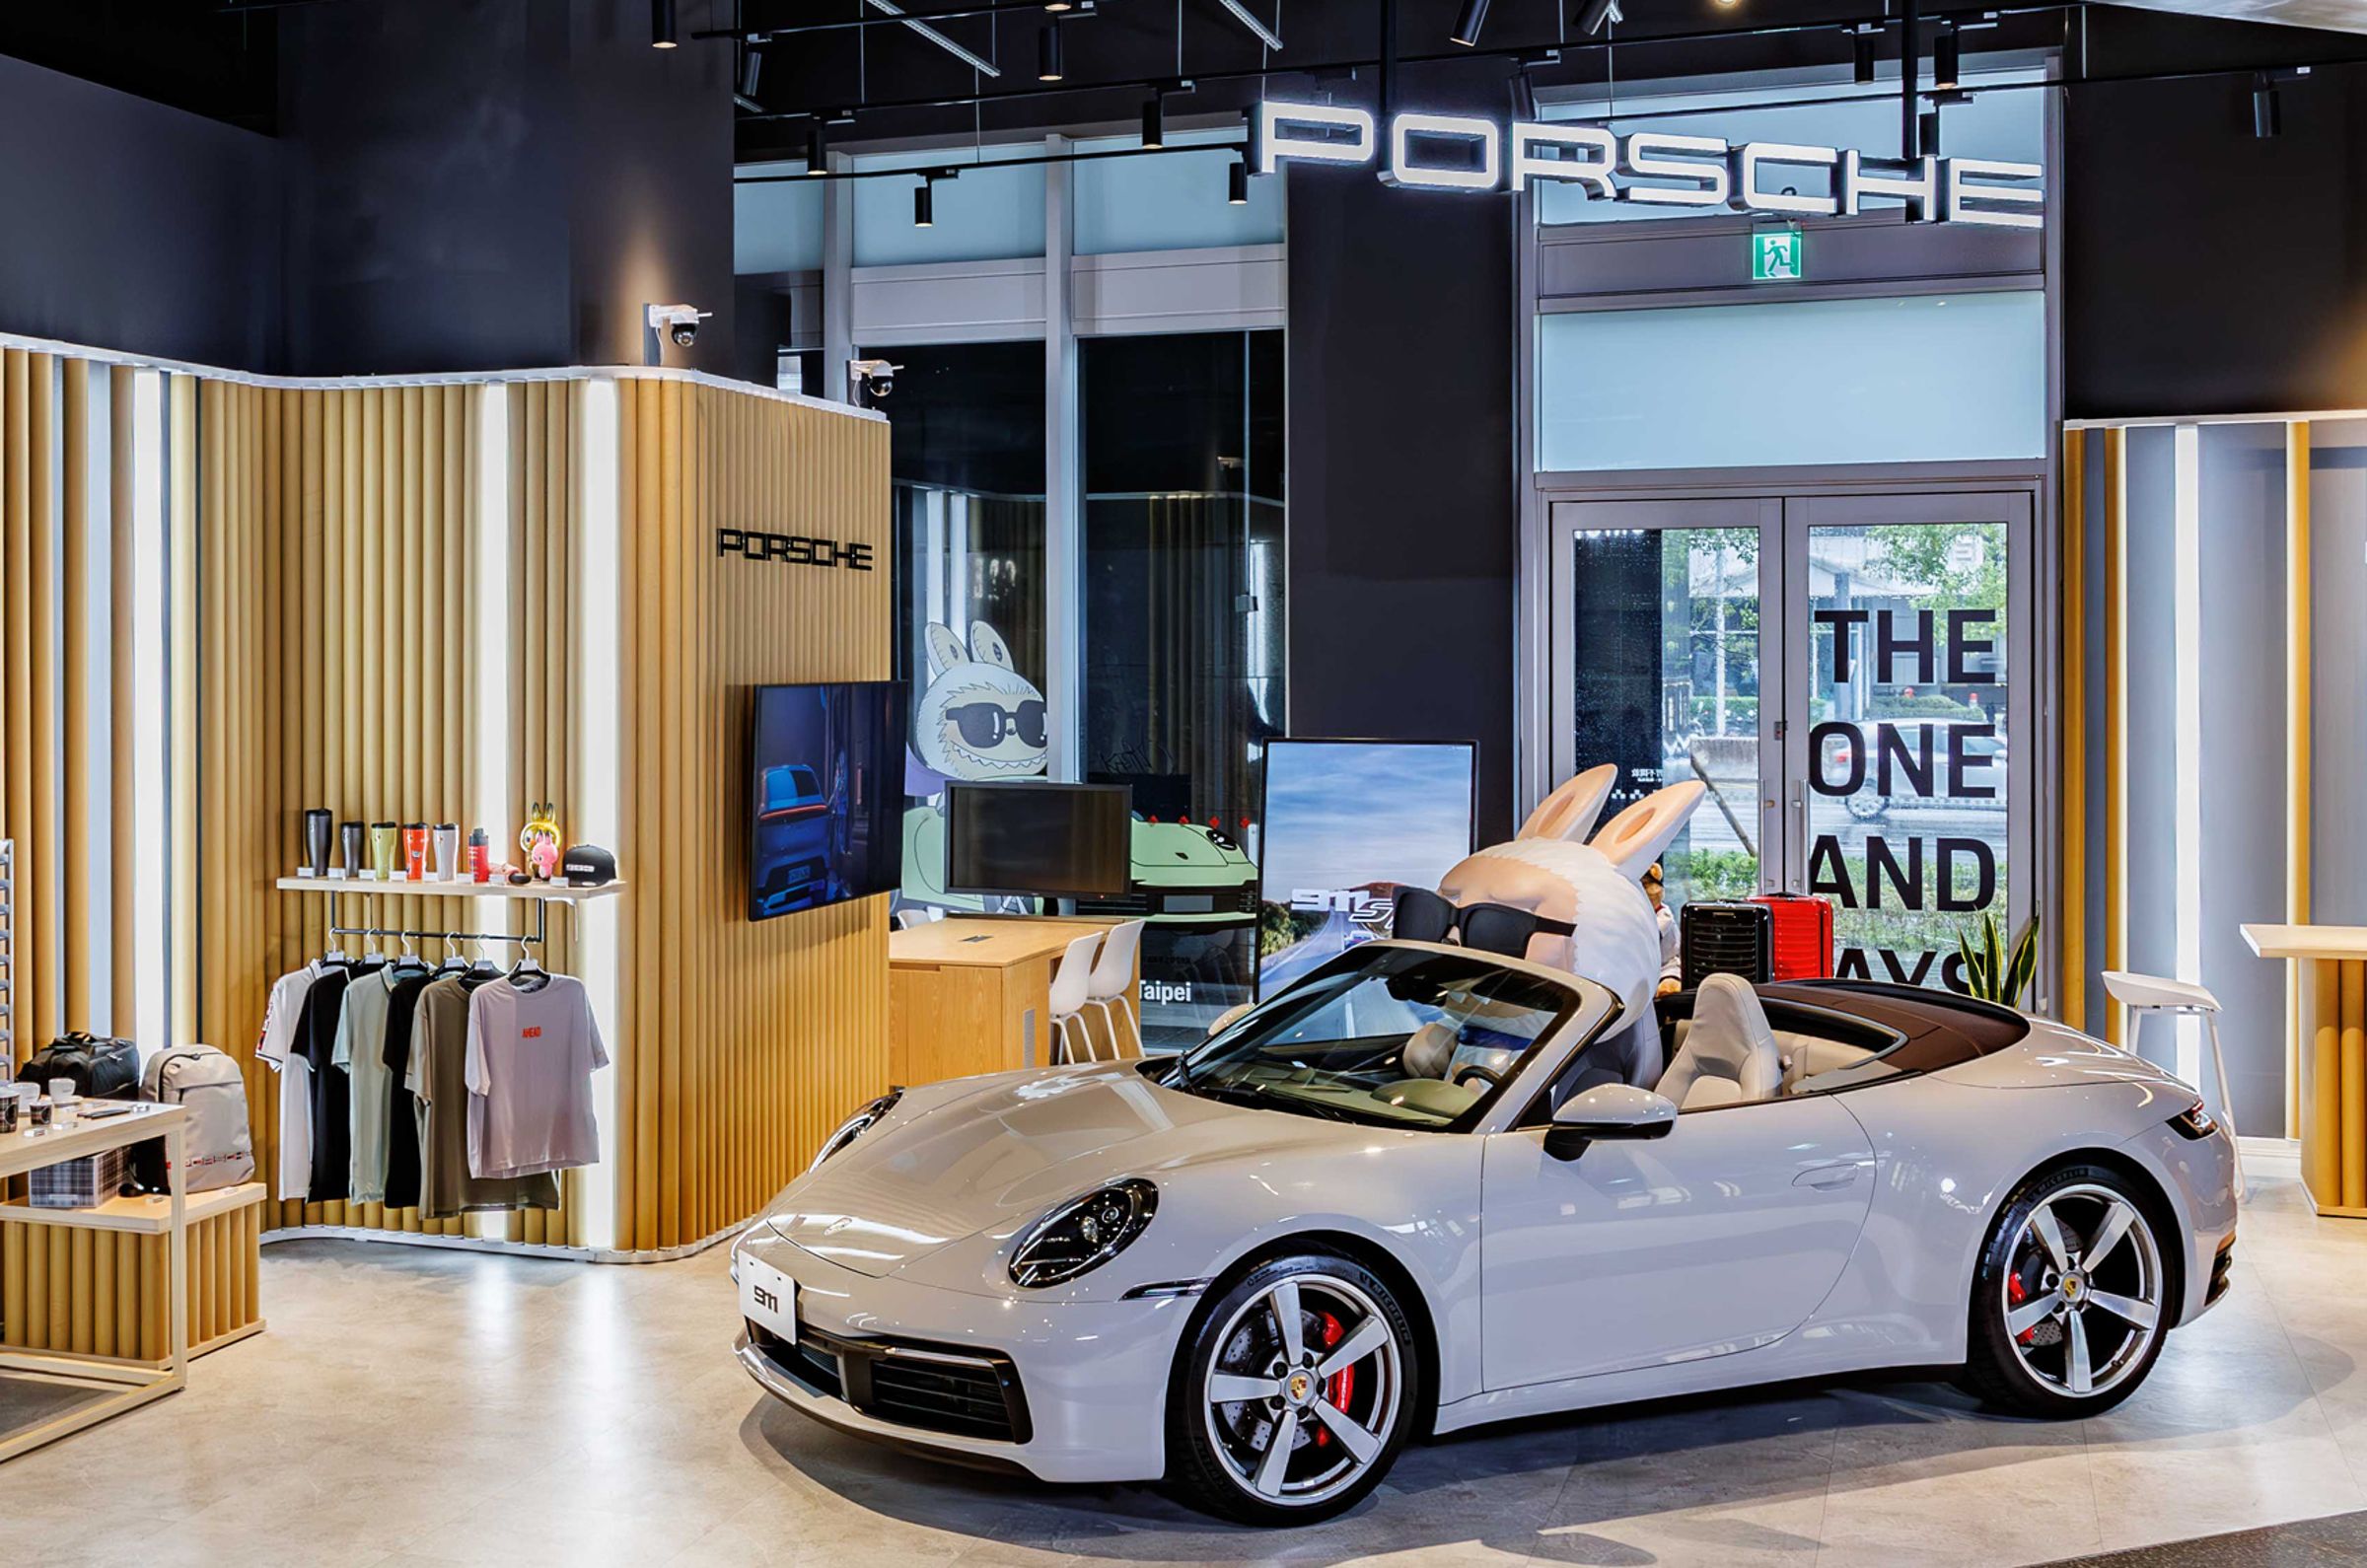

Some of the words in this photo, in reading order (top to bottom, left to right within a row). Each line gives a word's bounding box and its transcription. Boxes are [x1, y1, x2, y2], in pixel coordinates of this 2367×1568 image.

[1257, 100, 2044, 229] PORSCHE
[717, 528, 873, 571] PORSCHE
[1814, 609, 1995, 683] THE
[1809, 721, 1995, 798] ONE
[1291, 889, 1370, 912] 911
[1809, 835, 1995, 912] AND
[1139, 979, 1191, 1006] Taipei
[753, 1284, 779, 1315] 911
